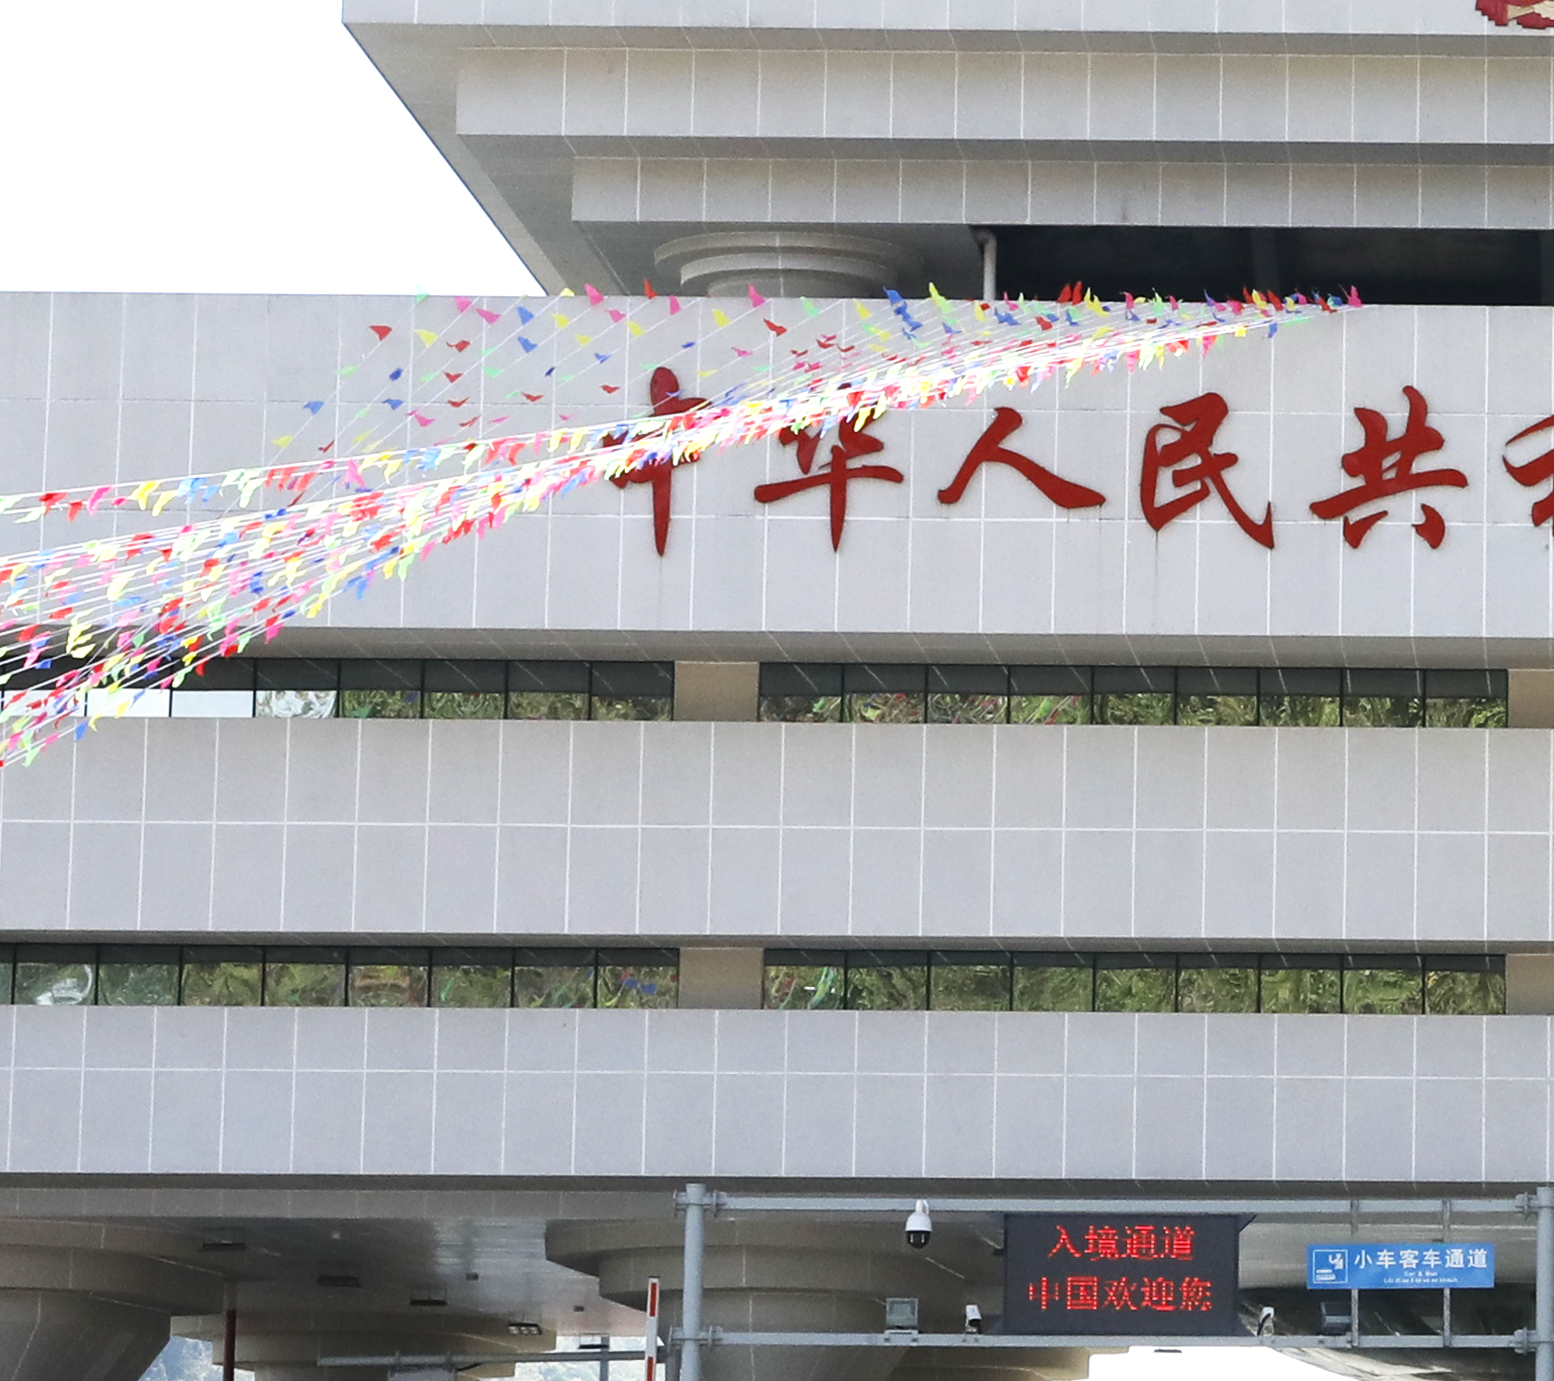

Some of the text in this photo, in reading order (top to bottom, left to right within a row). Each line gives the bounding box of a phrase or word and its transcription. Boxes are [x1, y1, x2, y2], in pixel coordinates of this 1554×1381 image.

[1048, 1224, 1196, 1262] 入境通道
[1354, 1248, 1488, 1269] 小车客车通道
[1028, 1276, 1213, 1312] 中国欢迎您
